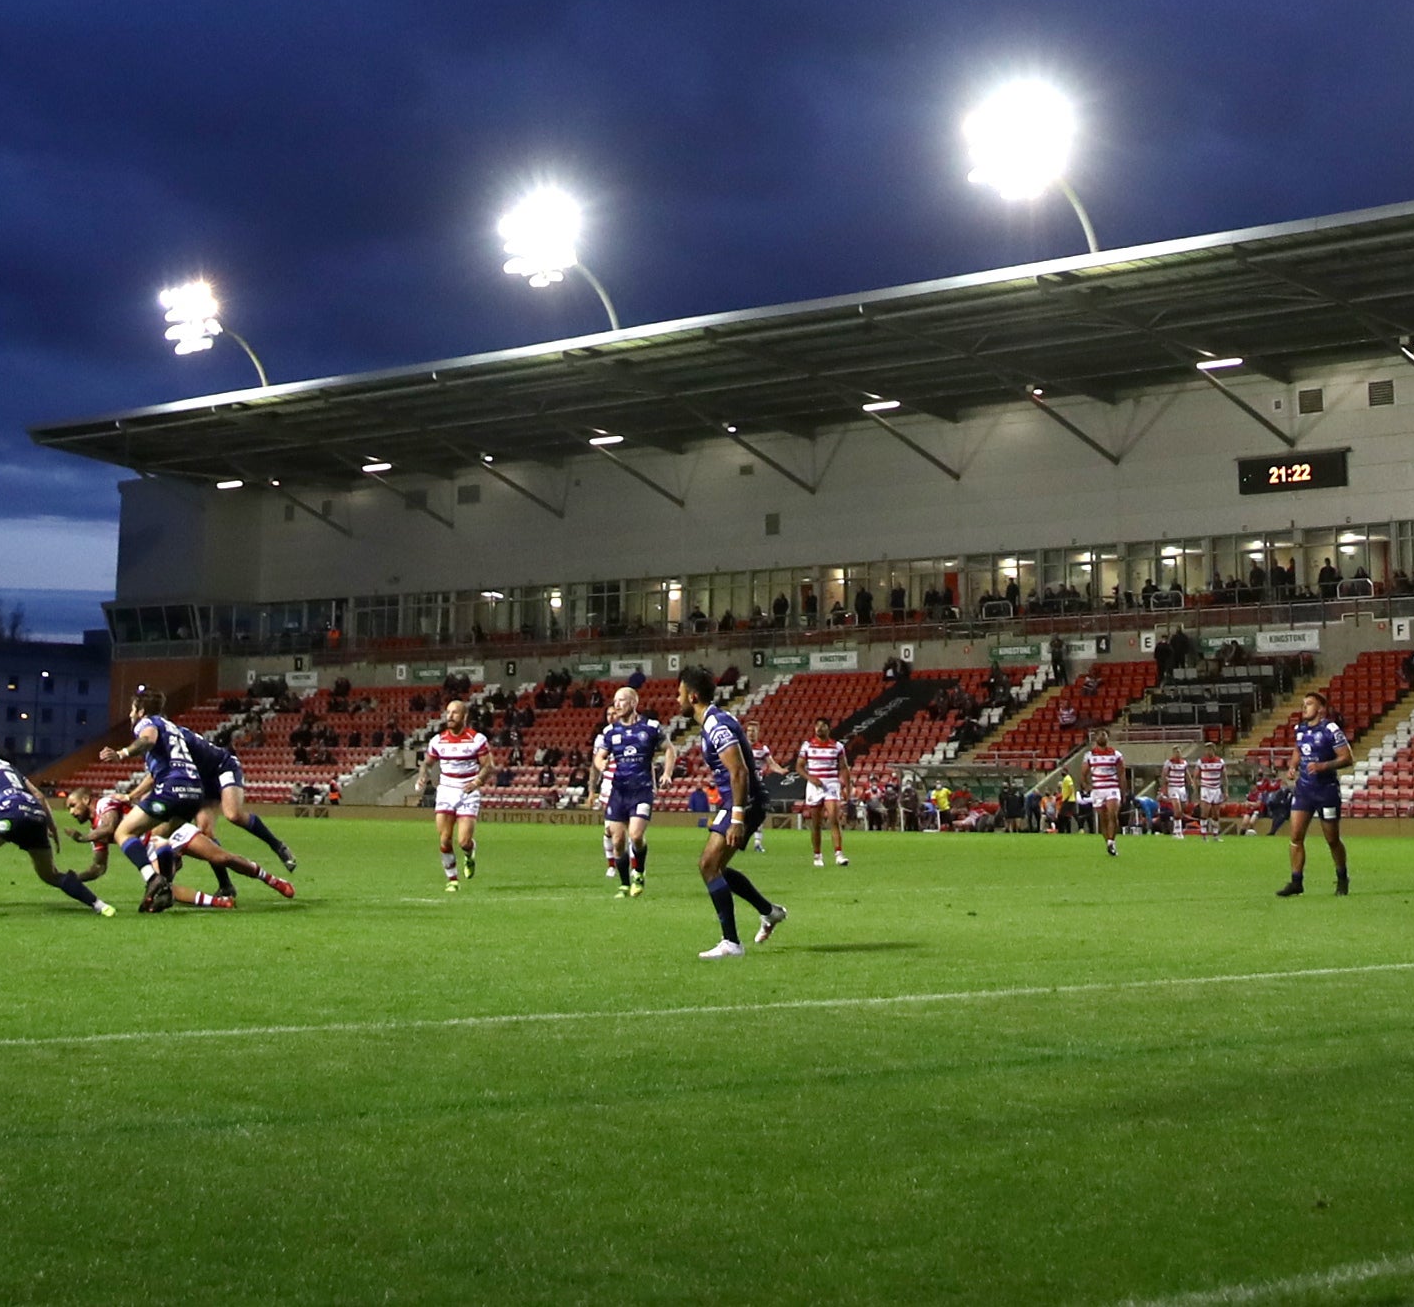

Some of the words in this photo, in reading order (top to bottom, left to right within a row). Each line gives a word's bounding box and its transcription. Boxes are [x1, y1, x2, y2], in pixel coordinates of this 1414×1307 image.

[1268, 463, 1311, 483] 21:22
[1396, 624, 1405, 636] F
[1099, 638, 1107, 650] 4
[1144, 637, 1153, 648] E
[1268, 634, 1306, 643] KINGSTONE
[755, 653, 762, 665] 3
[903, 648, 911, 659] D
[669, 657, 677, 668] C
[507, 663, 514, 674] 2
